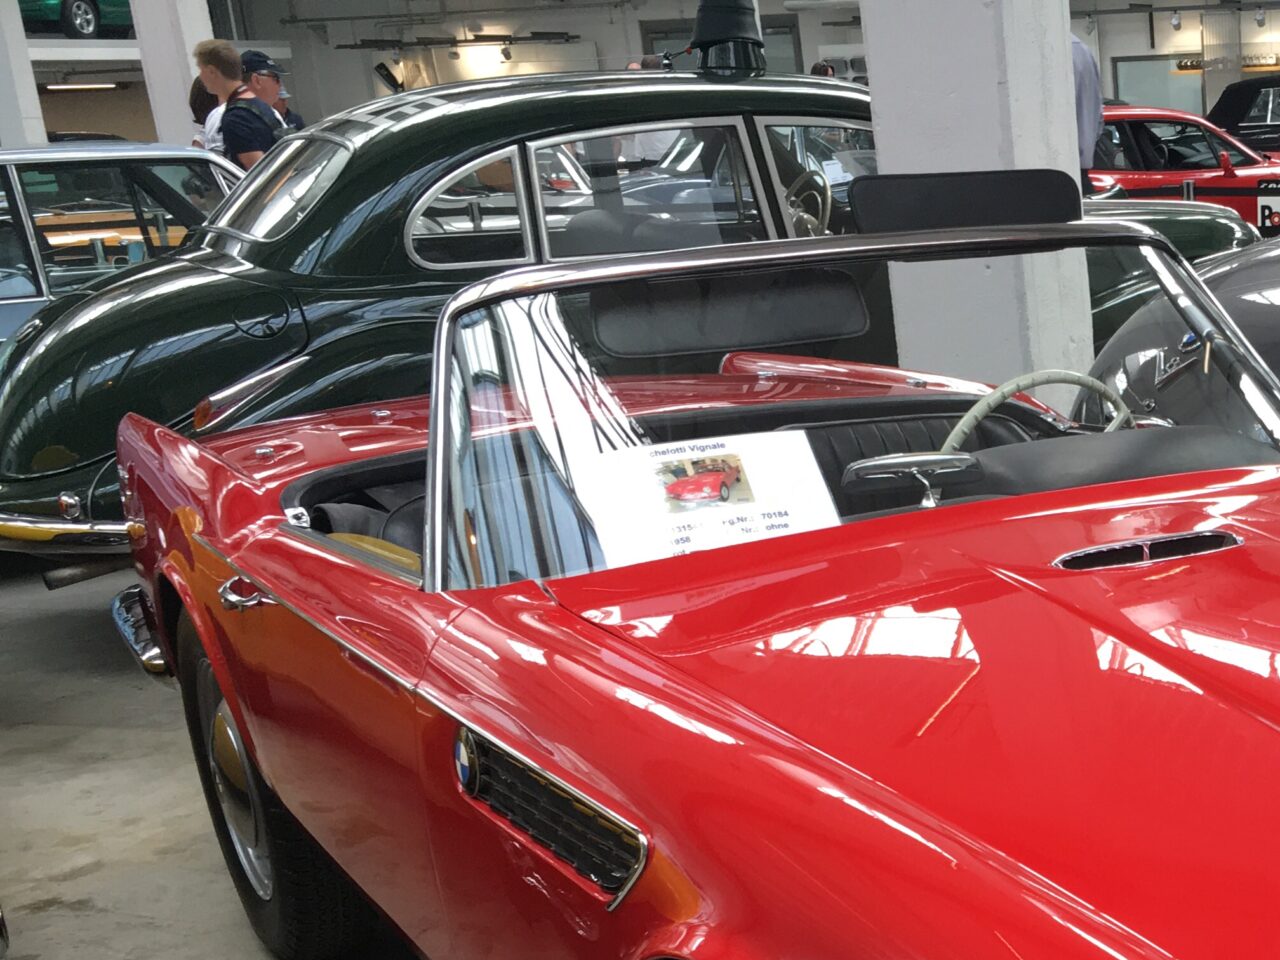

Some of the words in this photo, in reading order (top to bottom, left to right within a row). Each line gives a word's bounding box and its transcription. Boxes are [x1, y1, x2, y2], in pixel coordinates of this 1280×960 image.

[687, 442, 726, 453] Vignale
[760, 510, 790, 520] 70184
[765, 523, 790, 532] ohne
